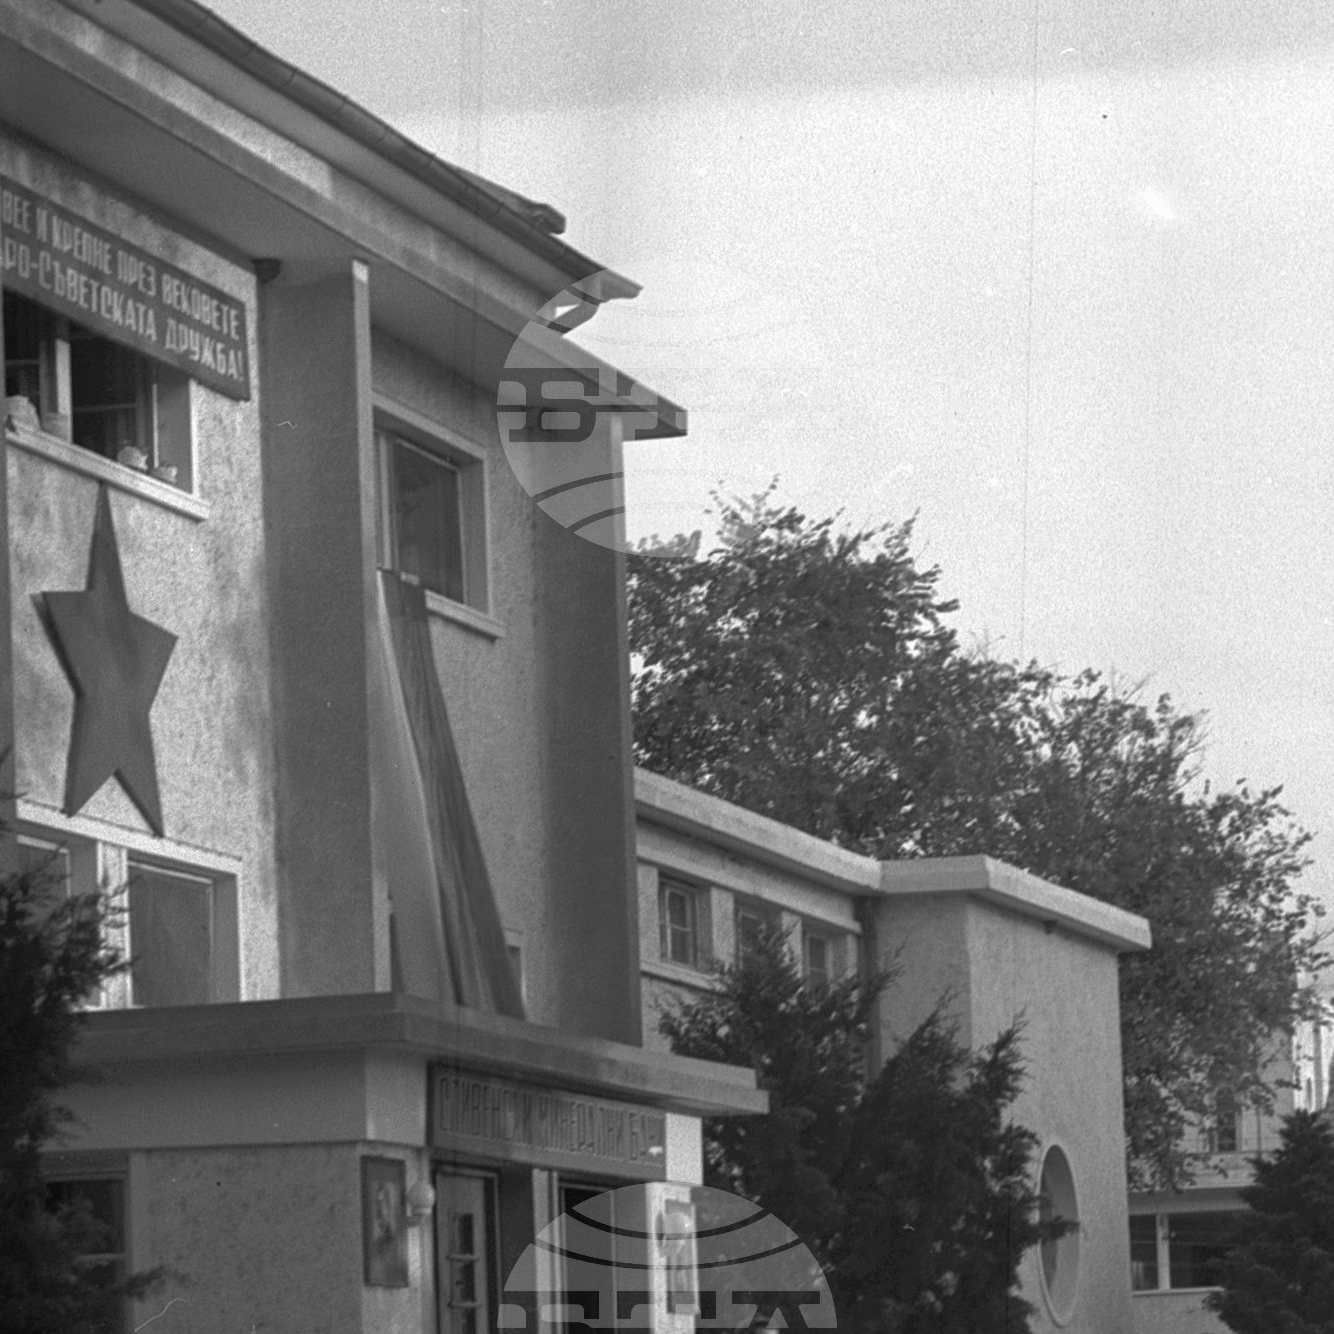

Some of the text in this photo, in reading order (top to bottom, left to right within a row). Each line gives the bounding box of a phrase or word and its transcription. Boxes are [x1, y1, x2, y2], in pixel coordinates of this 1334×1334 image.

[36, 207, 47, 243] И
[52, 216, 113, 275] КРЕПНЕ
[117, 249, 156, 298] ПРЕЗ
[161, 272, 240, 341] ВЕКОВЕТЕ
[165, 317, 244, 382] ДРУЖБА!
